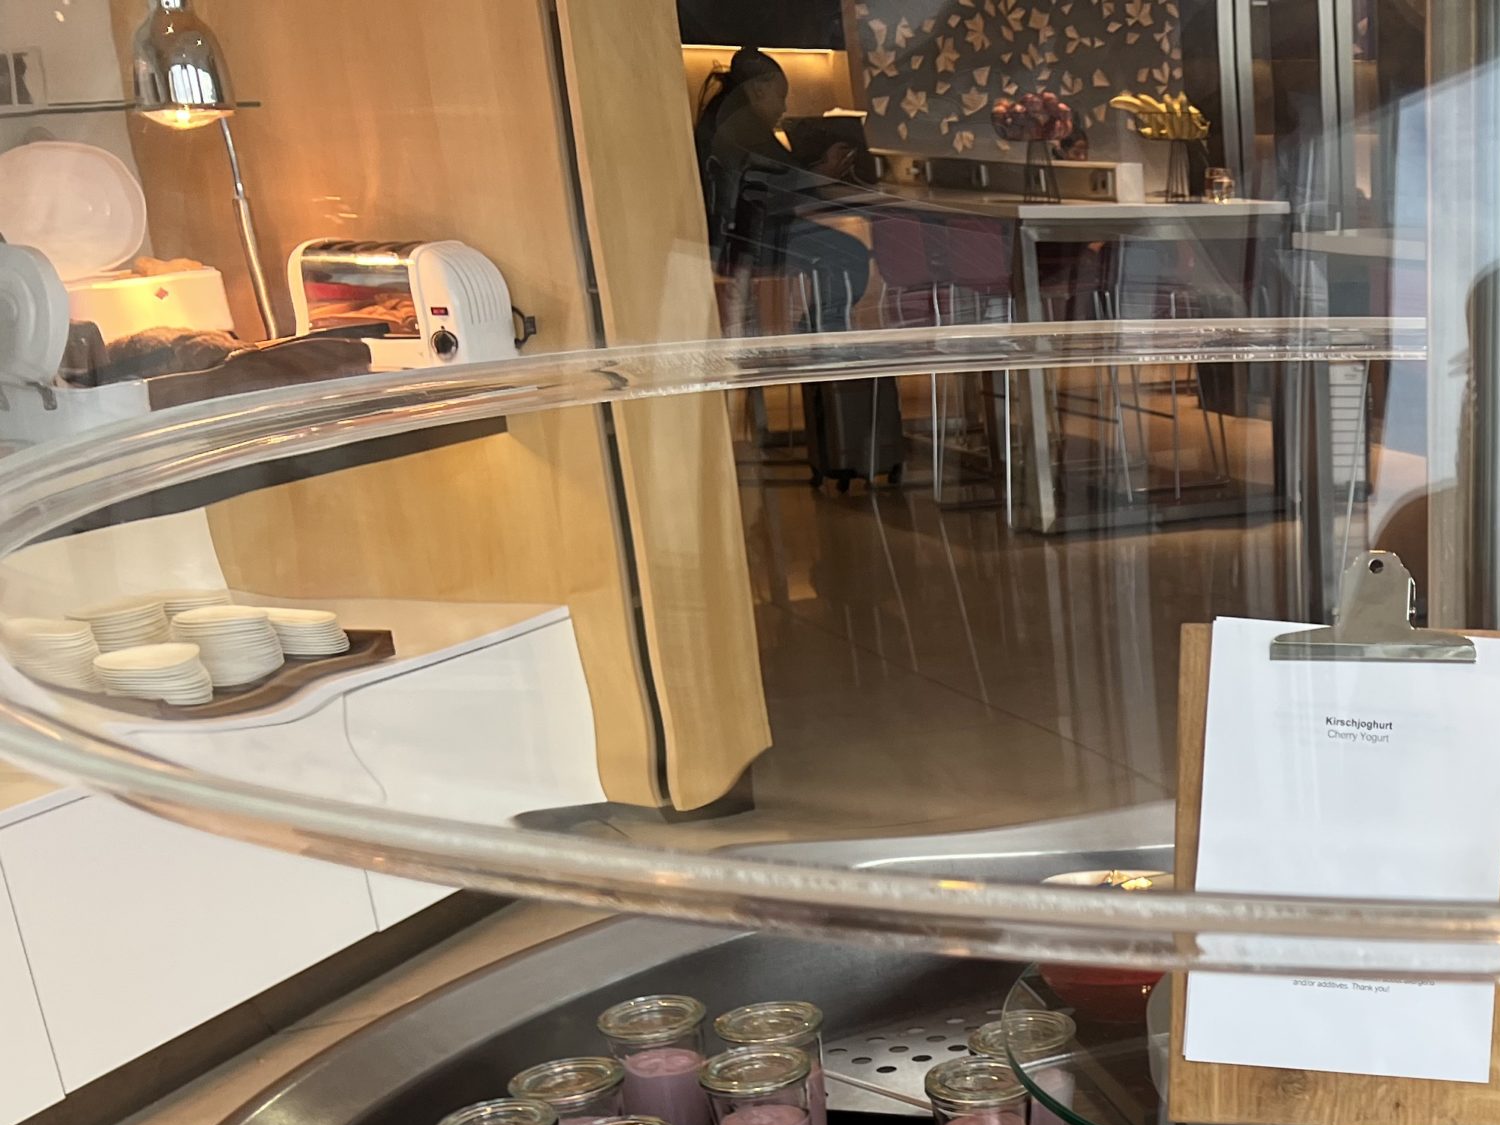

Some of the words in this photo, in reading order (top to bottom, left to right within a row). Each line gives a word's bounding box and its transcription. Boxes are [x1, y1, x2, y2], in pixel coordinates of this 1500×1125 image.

[1325, 716, 1393, 730] Kirschjoghurt
[1327, 729, 1358, 742] Cherry
[1360, 732, 1389, 743] Yogurt
[1352, 982, 1373, 991] Thank
[1374, 985, 1390, 994] you!
